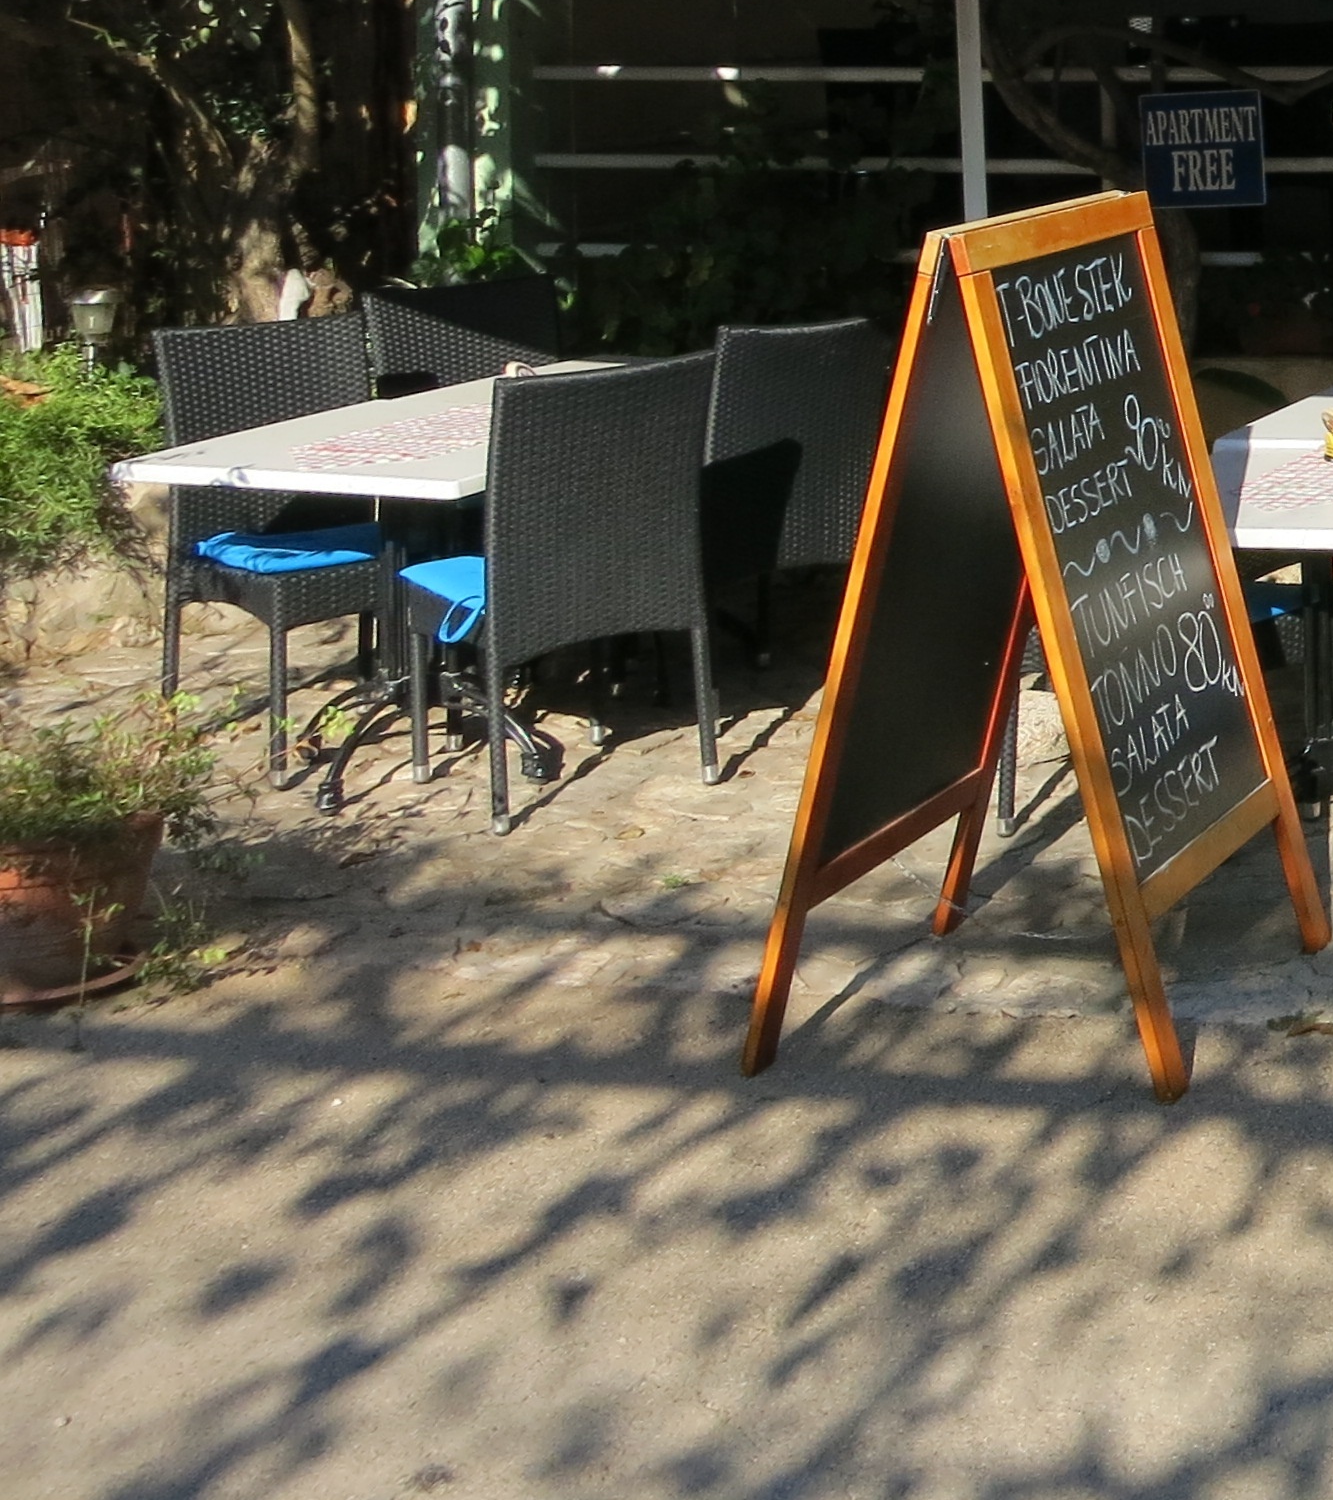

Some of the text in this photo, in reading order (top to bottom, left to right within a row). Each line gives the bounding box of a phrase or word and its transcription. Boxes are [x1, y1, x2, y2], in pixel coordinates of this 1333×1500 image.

[1146, 106, 1257, 146] APARTMENT
[1171, 148, 1236, 192] FREE
[1075, 253, 1132, 321] STEK
[1014, 328, 1141, 410] FIORENTINA
[1031, 402, 1105, 476] SALATA
[1045, 459, 1132, 534] DESSERT
[1071, 553, 1188, 658] TUNFISCH
[1091, 624, 1177, 735] TONNO
[1111, 693, 1190, 798] SALATA
[1124, 735, 1220, 868] DESSERT
